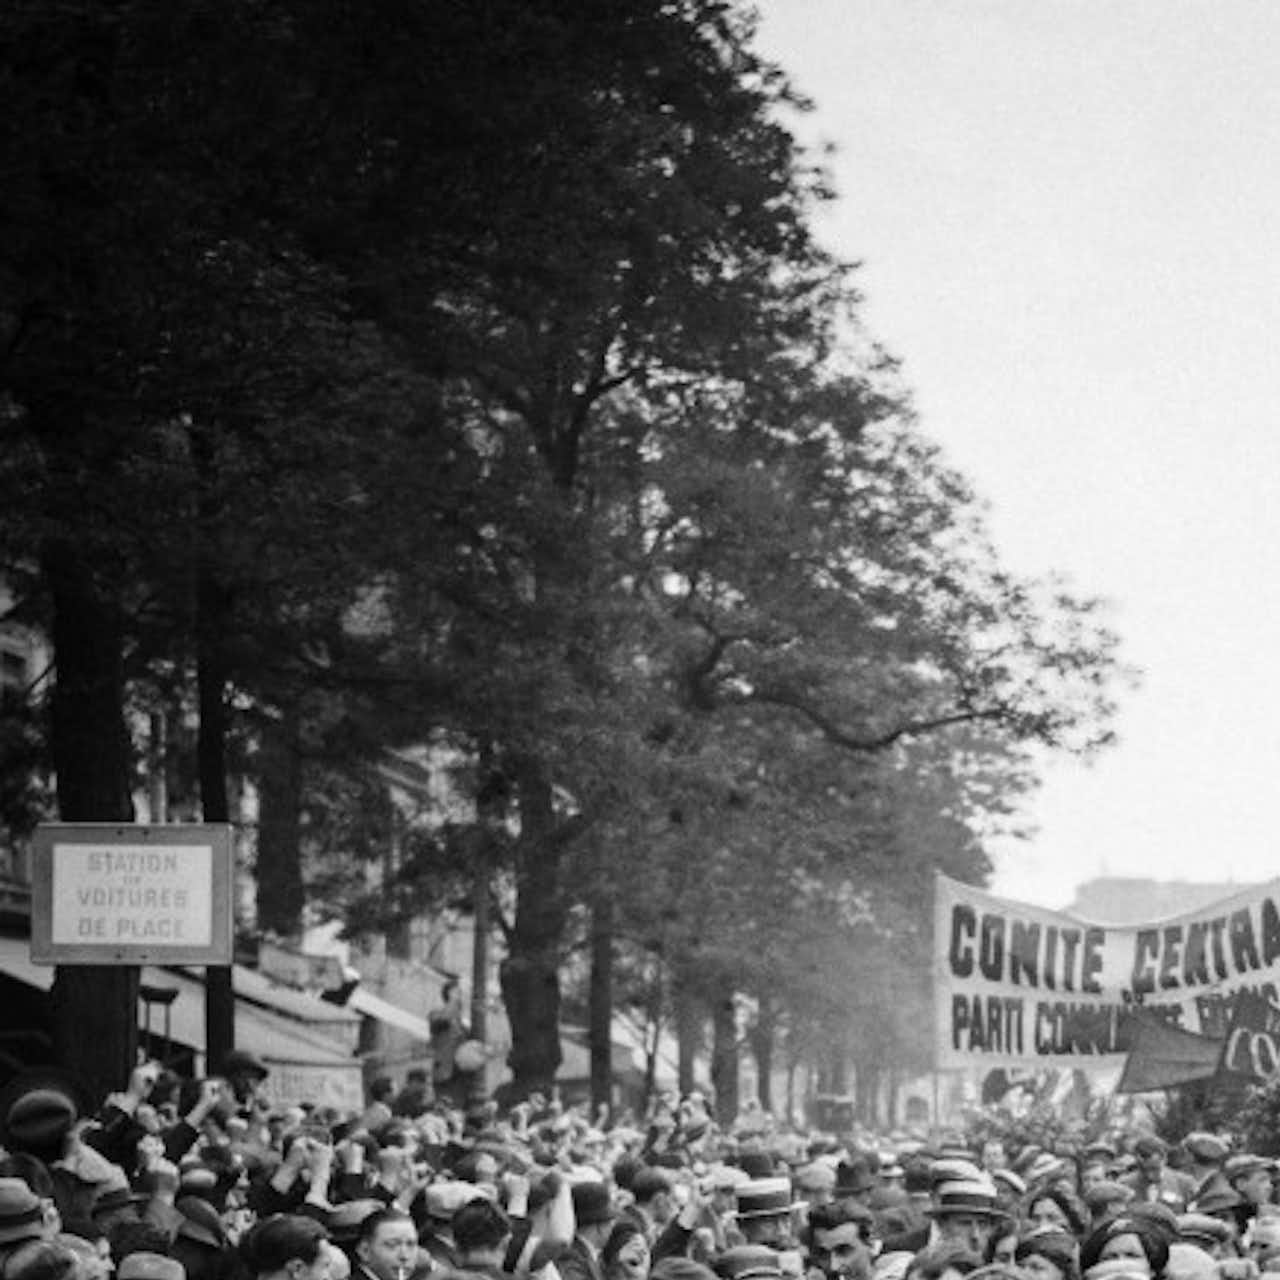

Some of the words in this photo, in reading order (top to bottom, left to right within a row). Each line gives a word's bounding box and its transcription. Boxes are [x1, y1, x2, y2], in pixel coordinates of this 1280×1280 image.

[88, 851, 178, 873] STATION
[77, 887, 189, 908] VOITURES
[78, 917, 106, 937] DE
[116, 917, 184, 938] PLACE
[949, 903, 1105, 994] COMITE
[952, 994, 1023, 1055] PARTI
